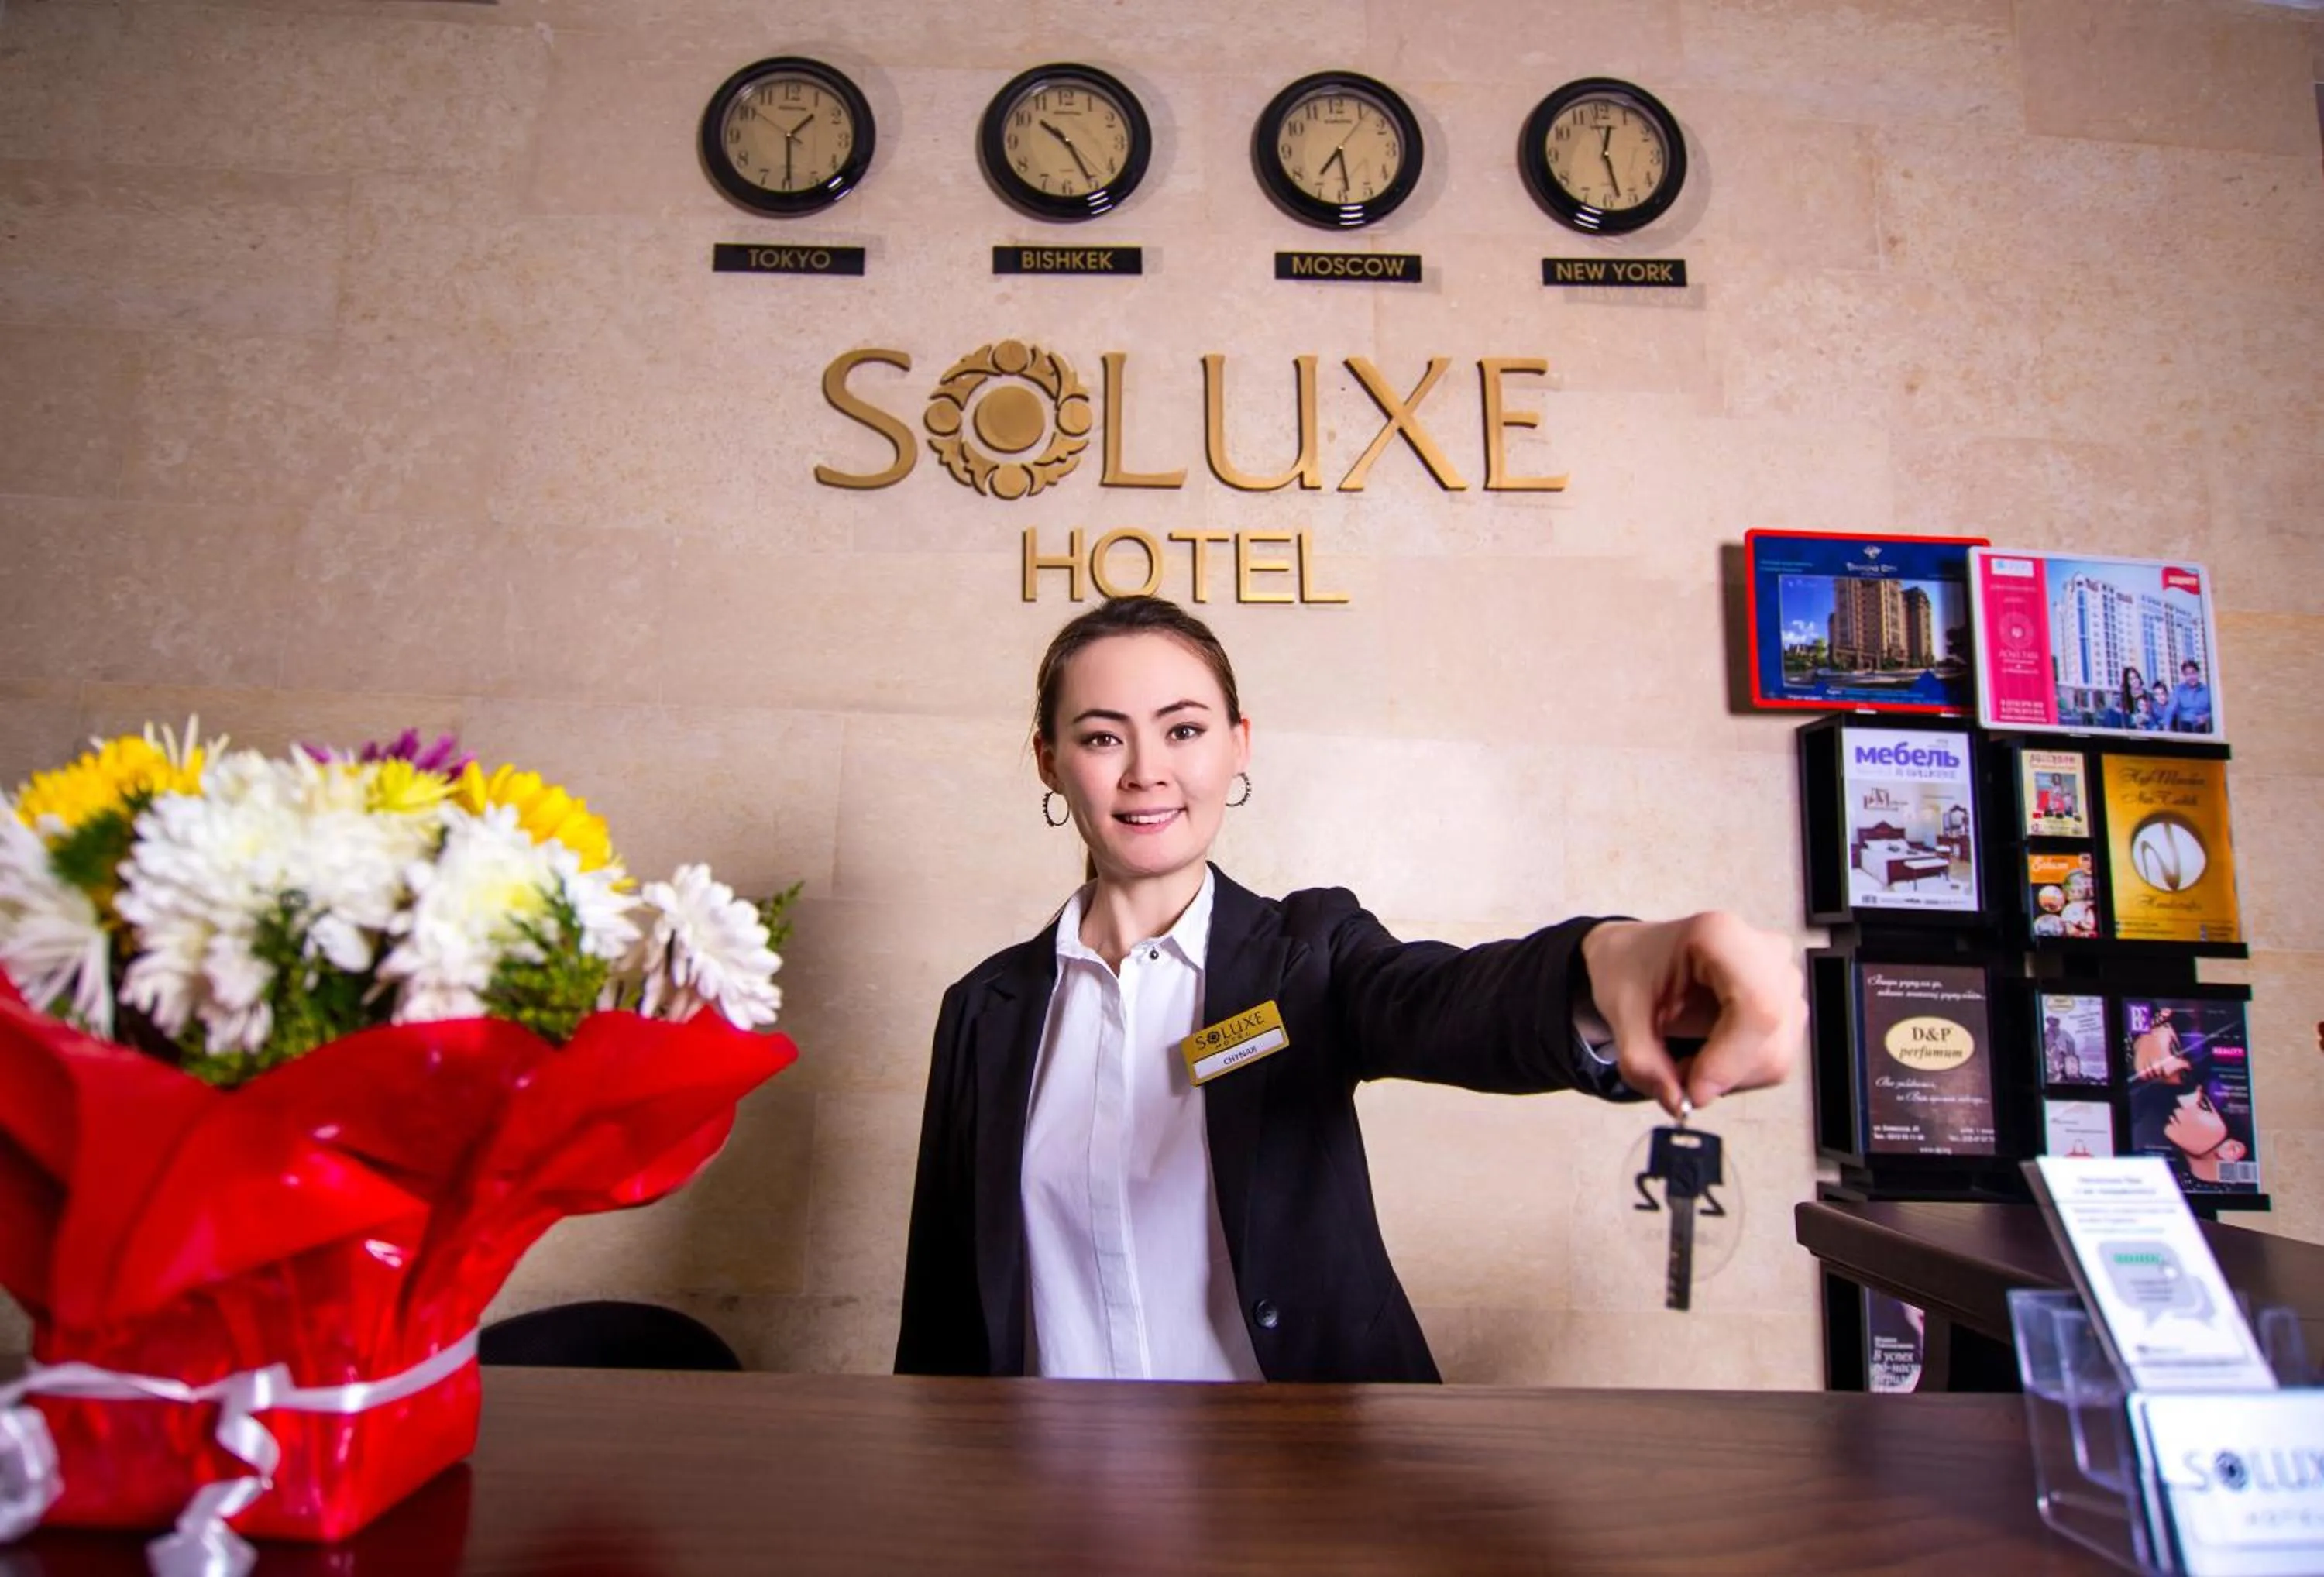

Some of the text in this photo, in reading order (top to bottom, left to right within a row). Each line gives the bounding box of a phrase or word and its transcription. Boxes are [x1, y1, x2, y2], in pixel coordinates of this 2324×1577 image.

[760, 86, 772, 105] 11
[785, 83, 801, 101] 12
[815, 91, 819, 108] 1
[1058, 90, 1074, 106] 12
[1034, 94, 1046, 111] 11
[1088, 95, 1092, 112] 1
[1328, 98, 1344, 114] 12
[1358, 102, 1363, 119] 1
[739, 105, 756, 120] 10
[831, 107, 841, 124] 2
[1016, 111, 1031, 126] 10
[1305, 104, 1317, 120] 11
[1573, 109, 1584, 125] 11
[1594, 103, 1610, 119] 12
[1623, 110, 1627, 125] 1
[1105, 112, 1115, 128] 2
[1288, 120, 1304, 136] 10
[1377, 119, 1387, 136] 2
[729, 128, 740, 143] 9
[838, 133, 850, 149] 3
[1555, 125, 1570, 141] 10
[1641, 125, 1650, 142] 2
[1008, 135, 1018, 149] 9
[1115, 134, 1125, 151] 3
[1385, 141, 1396, 158] 3
[738, 151, 748, 166] 8
[1281, 143, 1291, 159] 9
[1549, 147, 1559, 163] 9
[1650, 149, 1660, 165] 3
[829, 154, 837, 170] 4
[1017, 156, 1028, 173] 8
[1108, 157, 1116, 174] 4
[760, 168, 769, 185] 7
[1293, 167, 1303, 181] 8
[1381, 163, 1387, 180] 4
[1645, 171, 1653, 187] 4
[1040, 174, 1049, 190] 7
[1062, 179, 1073, 195] 6
[1363, 181, 1373, 196] 5
[1315, 183, 1324, 199] 7
[1581, 187, 1590, 204] 7
[1628, 188, 1638, 204] 5
[1603, 194, 1614, 208] 6
[748, 249, 830, 270] TOKYO
[1022, 251, 1113, 270] BISHKEK
[1292, 257, 1405, 277] MOSCOW
[1556, 263, 1673, 282] NEW YORK
[813, 339, 1570, 500] SOLUXE
[1022, 526, 1350, 603] HOTEL
[1855, 741, 1960, 768] мебель
[1195, 1011, 1264, 1050] SOLUXE
[1912, 1026, 1951, 1042] D&P
[1899, 1046, 1964, 1060] perfumum
